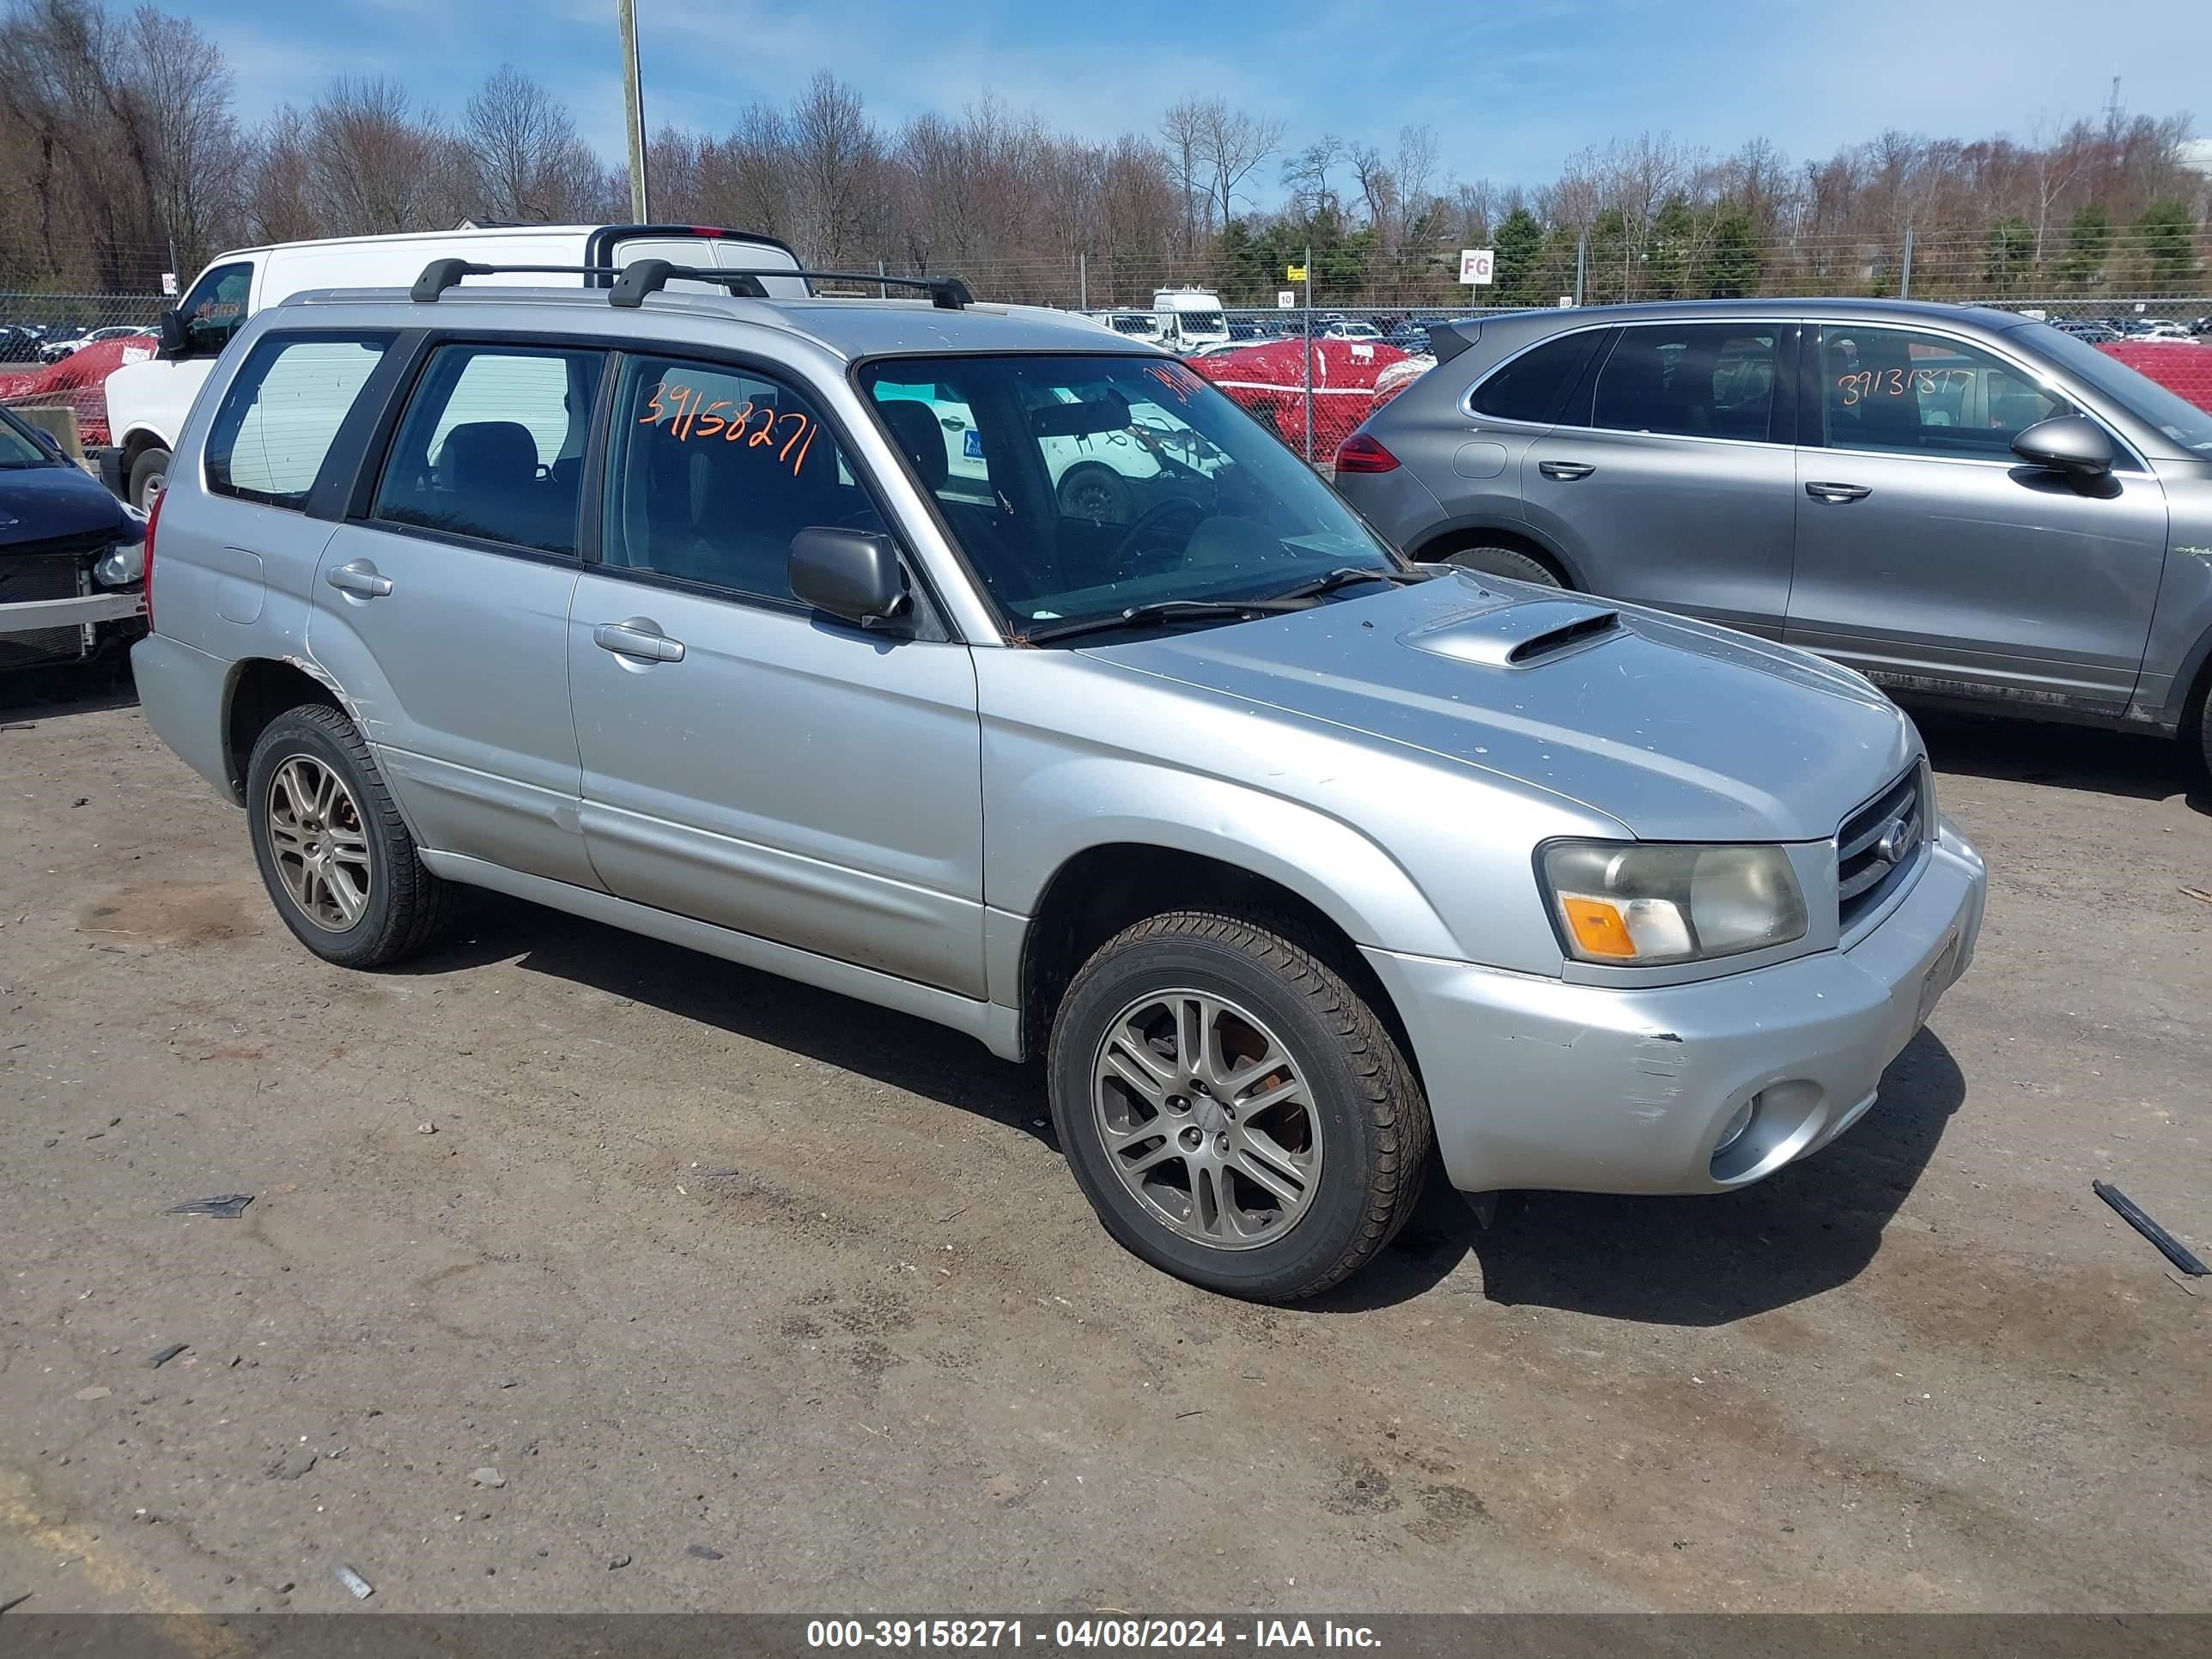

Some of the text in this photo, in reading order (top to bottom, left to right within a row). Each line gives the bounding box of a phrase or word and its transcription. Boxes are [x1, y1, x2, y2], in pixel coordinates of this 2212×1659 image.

[1464, 258, 1489, 276] FG
[1280, 295, 1291, 304] 10
[1838, 368, 1974, 405] 39131817
[639, 382, 817, 477] 39158271
